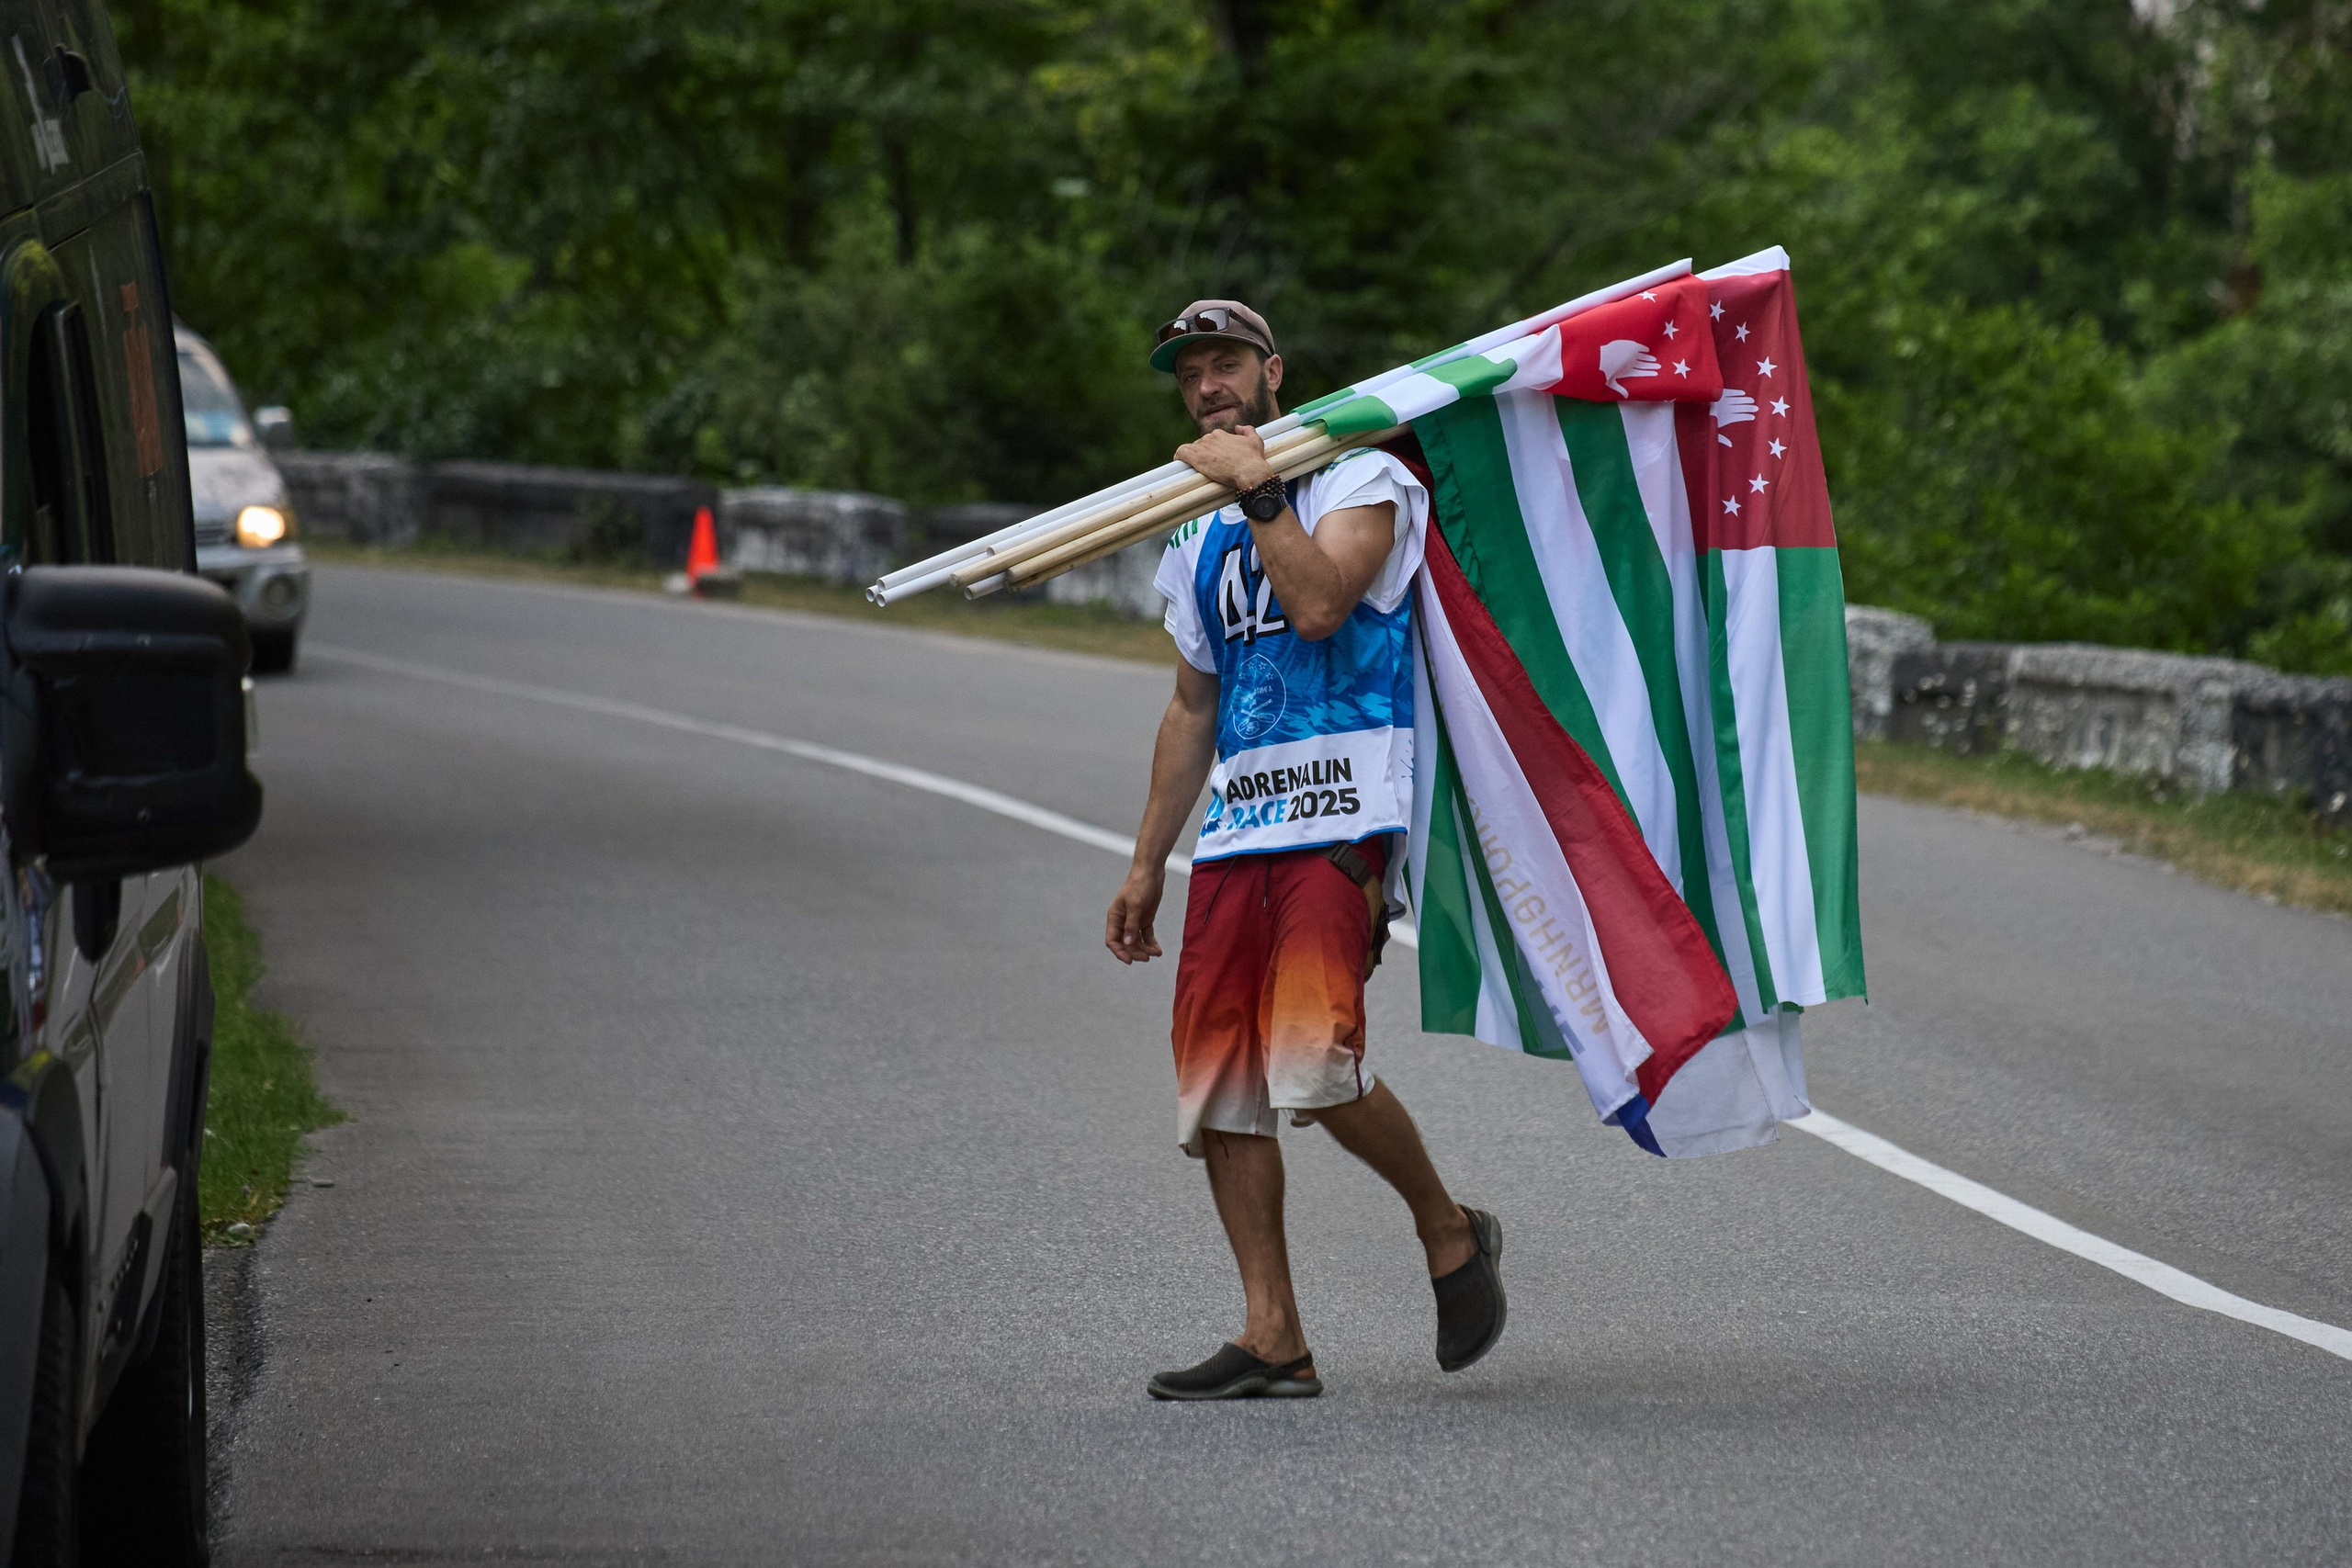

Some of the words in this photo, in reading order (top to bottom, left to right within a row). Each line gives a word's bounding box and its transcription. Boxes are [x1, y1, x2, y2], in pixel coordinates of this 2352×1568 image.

[1217, 542, 1290, 647] 42
[1227, 757, 1353, 805] ADRENALIN
[1227, 798, 1288, 831] RACE
[1286, 787, 1362, 823] 2025
